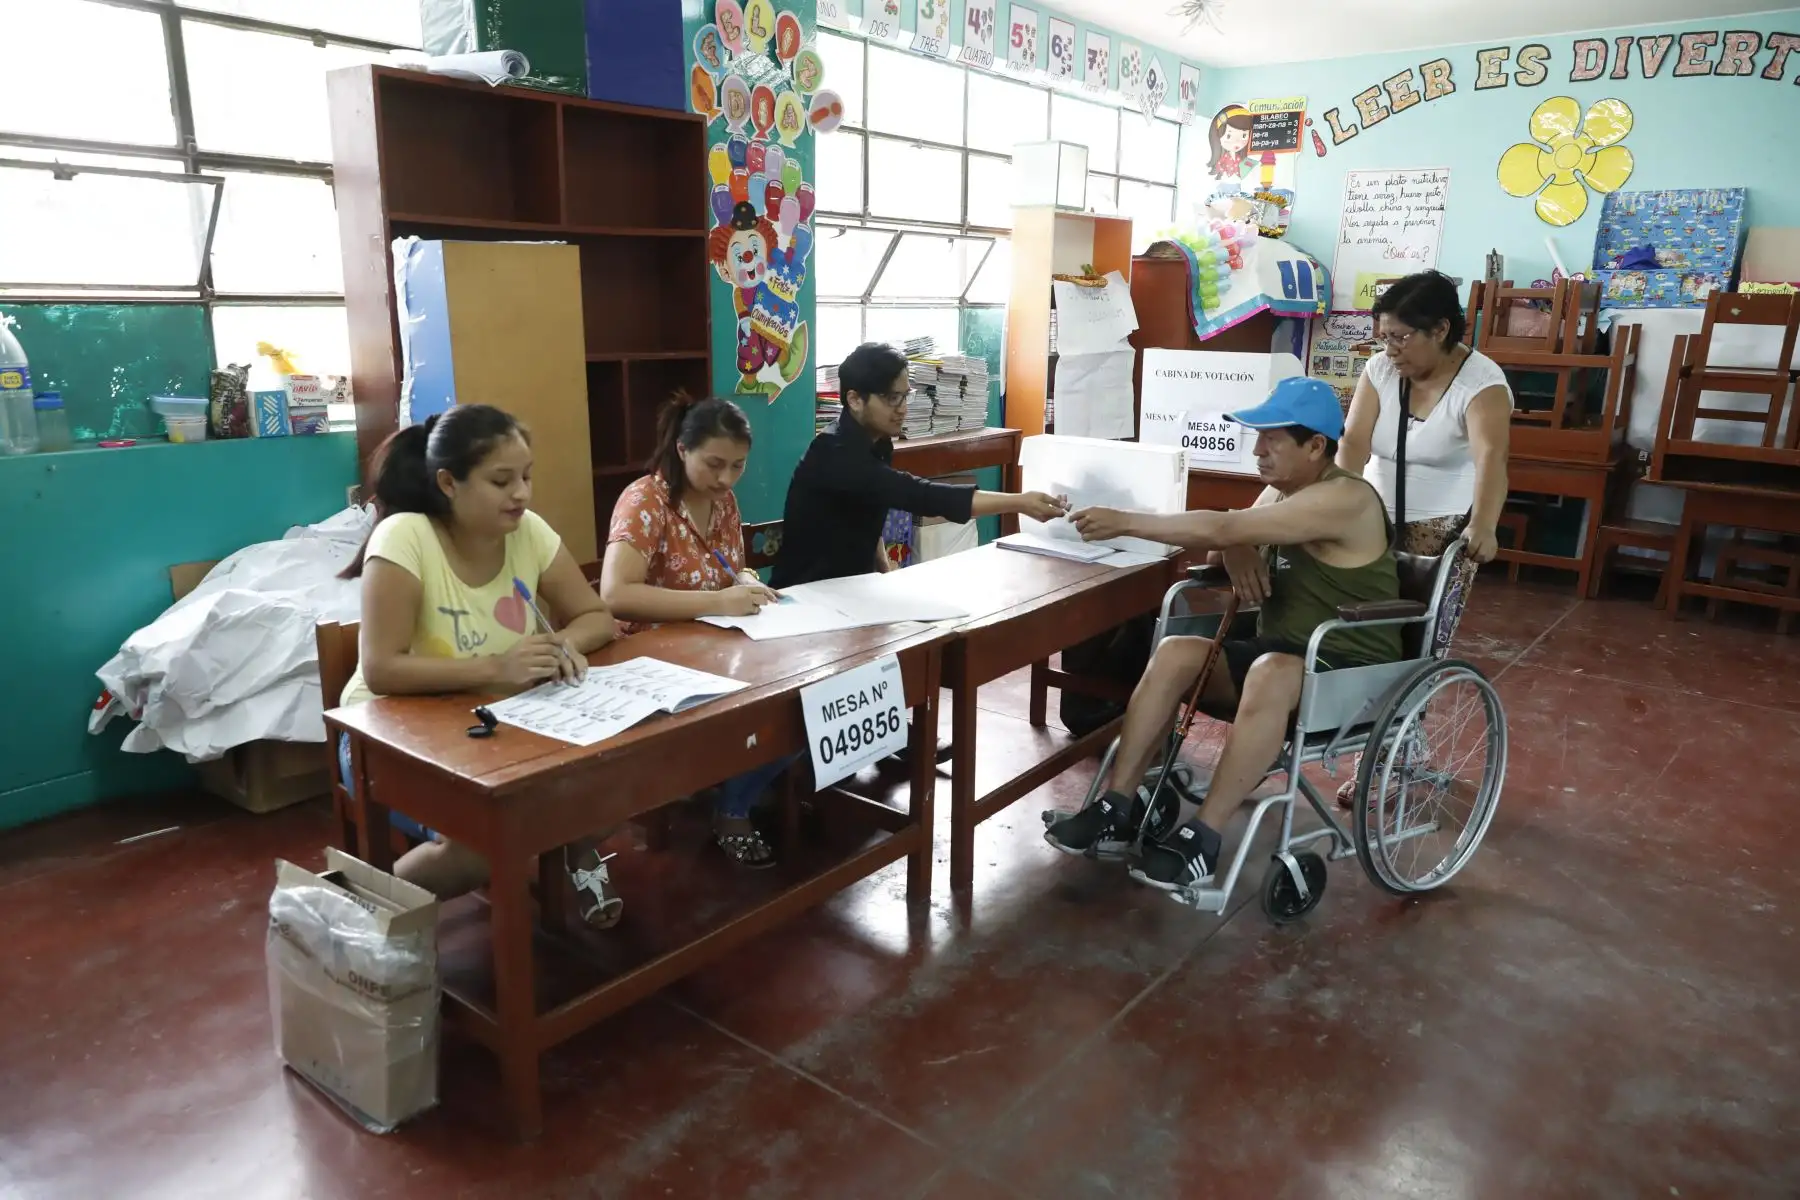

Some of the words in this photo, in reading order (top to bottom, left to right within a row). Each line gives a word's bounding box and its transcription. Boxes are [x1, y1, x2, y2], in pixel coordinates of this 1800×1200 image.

[868, 20, 889, 38] DOS
[967, 7, 981, 35] 4
[919, 35, 941, 53] TRES
[1010, 22, 1024, 48] 5
[1051, 34, 1063, 58] 6
[963, 46, 992, 66] CUATRO
[1087, 48, 1098, 70] 7
[1474, 44, 1551, 92] ES
[1569, 30, 1800, 87] DIVERT
[1120, 57, 1131, 78] 8
[1146, 68, 1157, 90] 9
[1180, 79, 1190, 100] 10
[1249, 99, 1304, 113] Comuniación
[1293, 119, 1299, 127] 3
[1292, 137, 1297, 145] 3
[1385, 173, 1407, 192] plato
[1348, 188, 1369, 201] tiene
[1400, 187, 1422, 199] huevo
[1405, 205, 1411, 219] y
[1363, 216, 1389, 236] ayuda
[1155, 368, 1188, 380] CABINA
[1190, 370, 1203, 380] DE
[1205, 371, 1255, 382] VOTACIÓN
[1144, 412, 1167, 422] MESA
[1187, 421, 1217, 433] MESA
[1181, 435, 1236, 452] 049856
[821, 690, 870, 723] MESA
[819, 705, 900, 765] 049856
